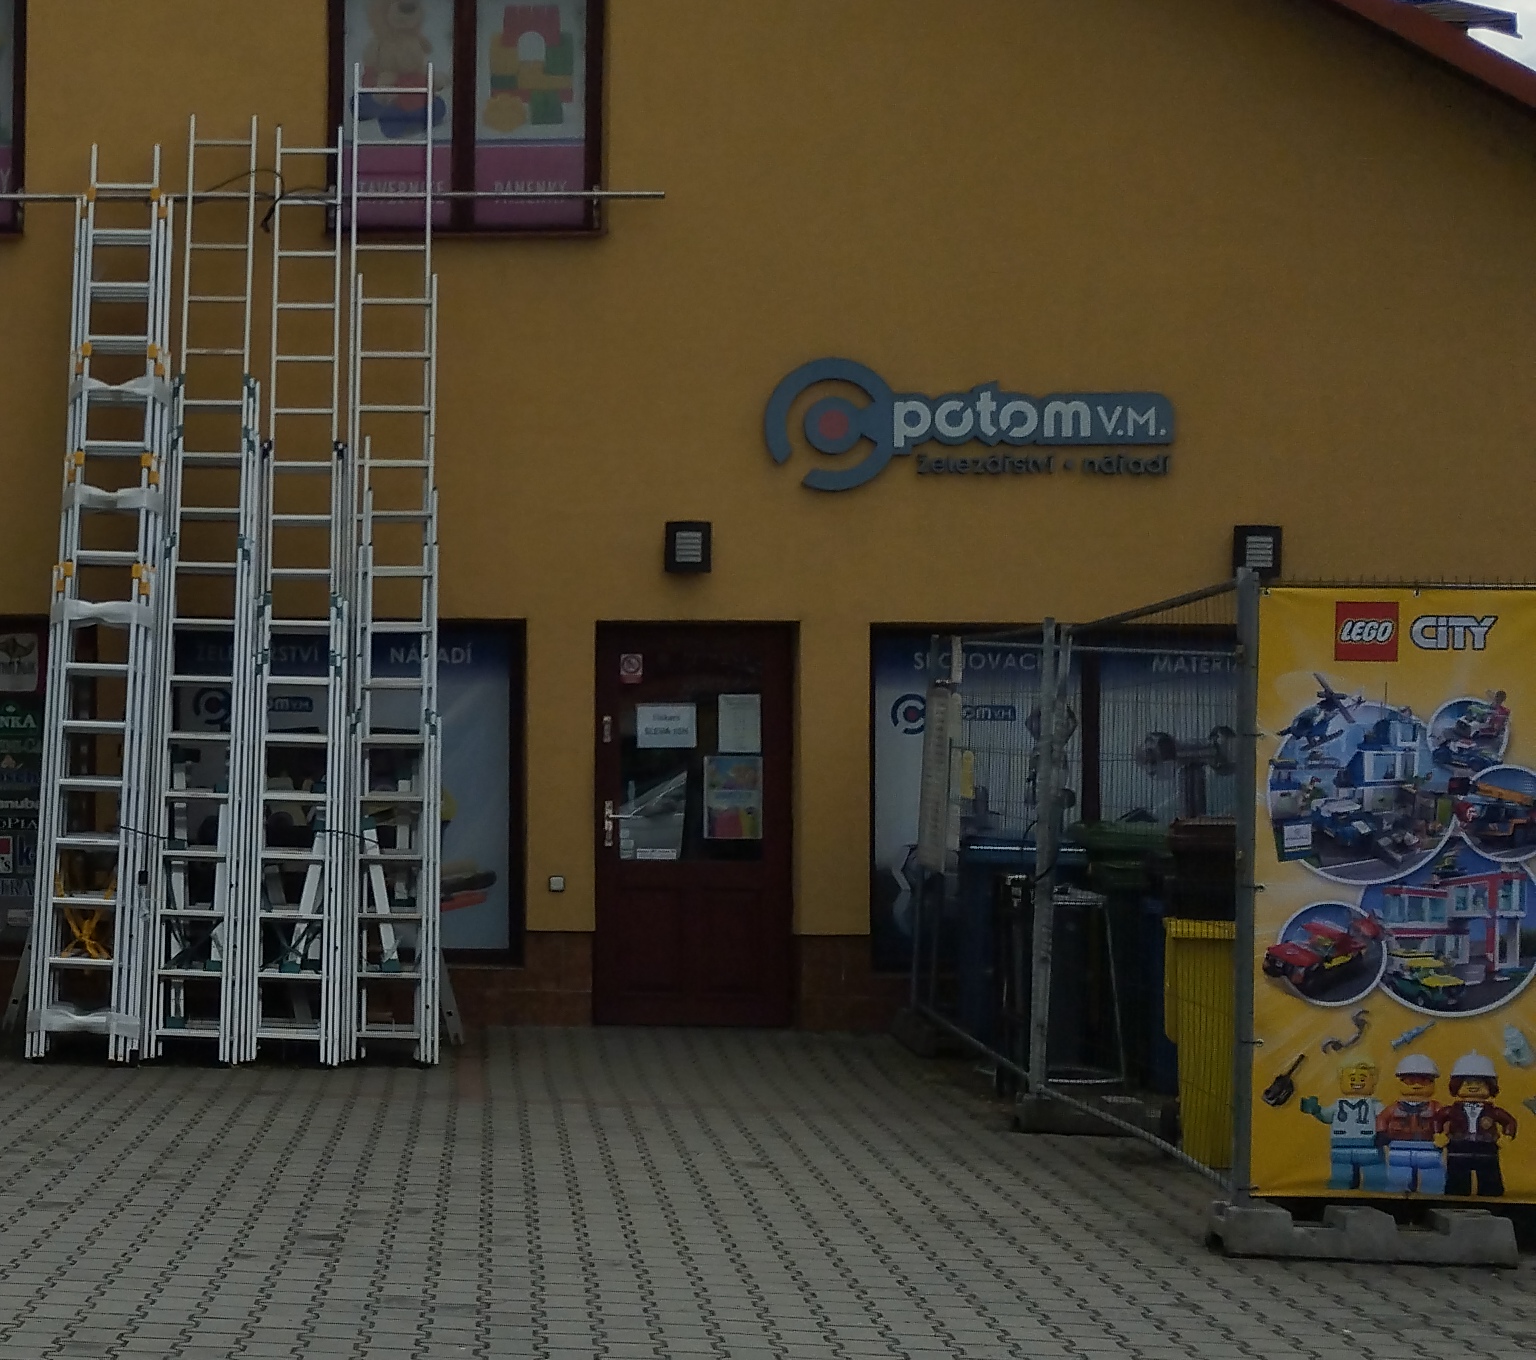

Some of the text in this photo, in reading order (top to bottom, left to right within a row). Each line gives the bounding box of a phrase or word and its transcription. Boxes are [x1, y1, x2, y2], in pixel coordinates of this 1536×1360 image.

[893, 390, 1167, 448] potom V.M.
[1339, 614, 1499, 651] LEGO CITY
[390, 641, 473, 664] NÁADÍ
